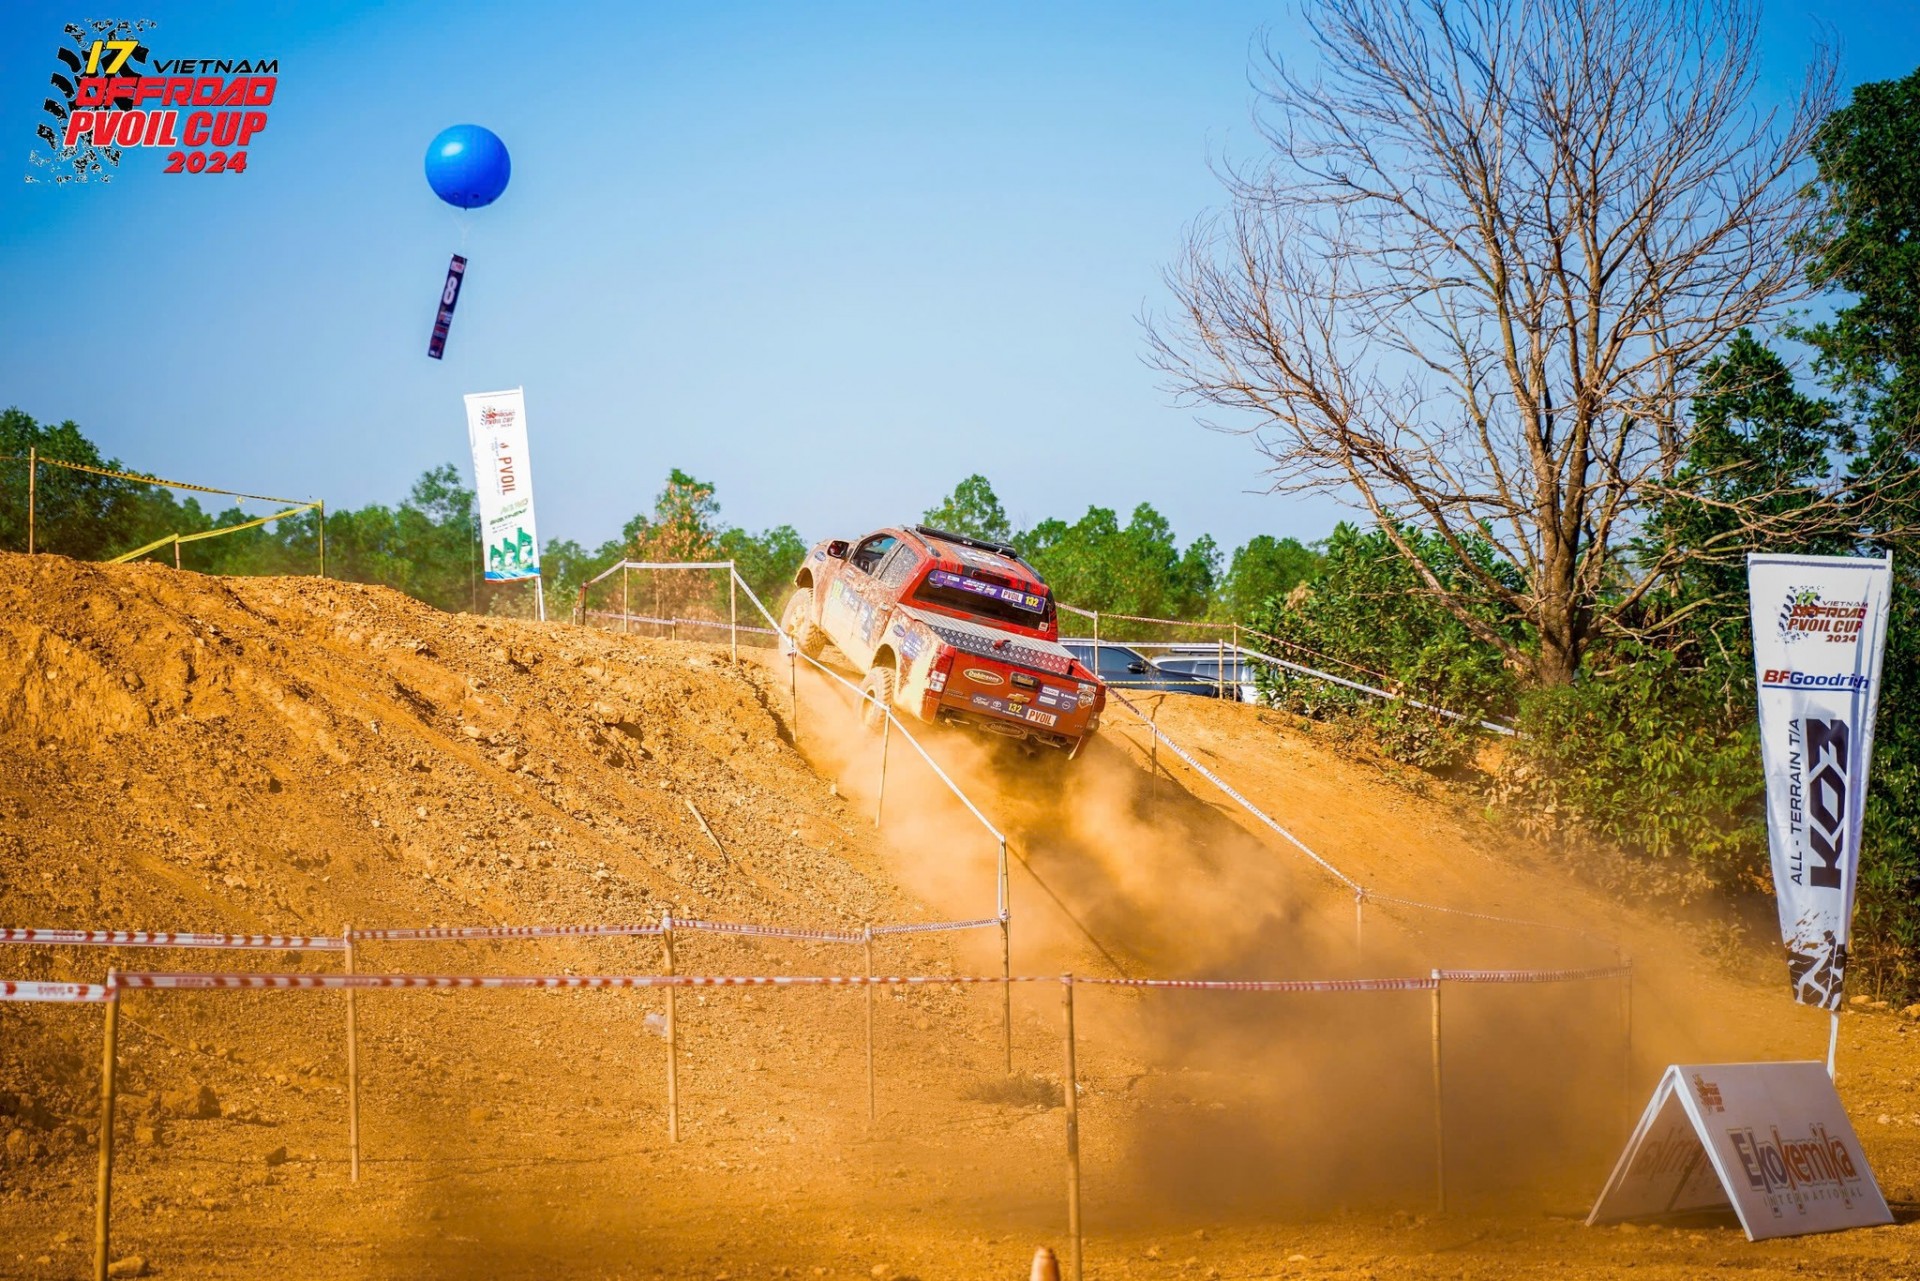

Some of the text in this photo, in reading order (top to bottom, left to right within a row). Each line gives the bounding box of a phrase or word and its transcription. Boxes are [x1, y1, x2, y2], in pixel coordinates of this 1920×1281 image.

[498, 456, 516, 496] PVOIL
[1002, 589, 1021, 602] PVOIL
[1025, 596, 1039, 608] 132
[1796, 591, 1819, 606] 17
[1822, 600, 1869, 609] VIETNAM
[1792, 606, 1868, 619] OFFROAD
[1787, 618, 1863, 634] PVOIL CUP
[1826, 634, 1857, 643] 2024
[1008, 702, 1023, 714] 132
[1028, 710, 1053, 725] PVOIL
[1789, 718, 1800, 746] T/A
[1790, 751, 1802, 835] TERRAIN
[1790, 851, 1802, 886] ALL
[1728, 1124, 1859, 1200] Ekokemika
